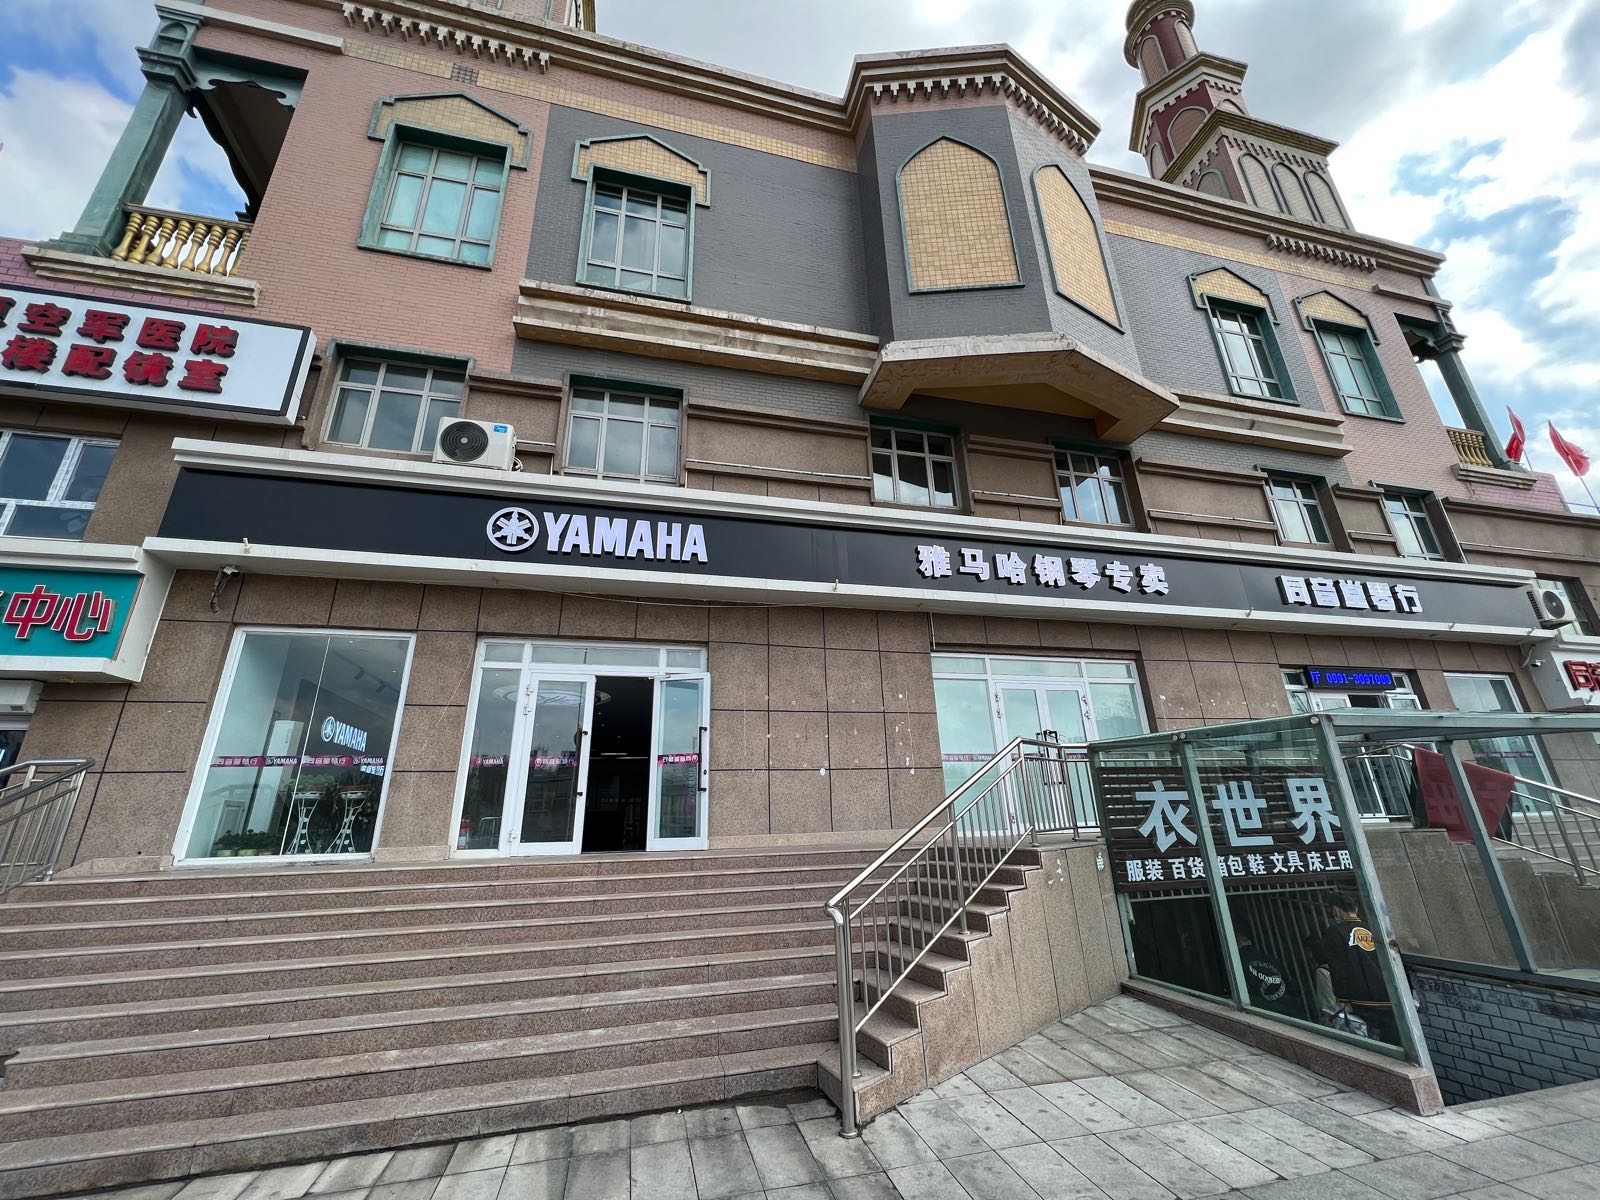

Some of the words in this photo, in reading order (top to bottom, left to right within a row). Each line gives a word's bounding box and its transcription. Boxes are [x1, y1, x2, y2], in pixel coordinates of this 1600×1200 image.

[543, 511, 708, 562] YAMAHA
[917, 544, 1169, 595] 雅马哈钢琴专卖
[2, 584, 113, 640] 中心
[273, 757, 298, 765] YAMAHA
[334, 721, 368, 752] YAMAHA
[1135, 778, 1341, 853] 衣世界
[1126, 859, 1164, 882] 服装
[1168, 856, 1206, 879] 百货
[1247, 854, 1267, 875] 鞋
[1270, 850, 1303, 874] 文具
